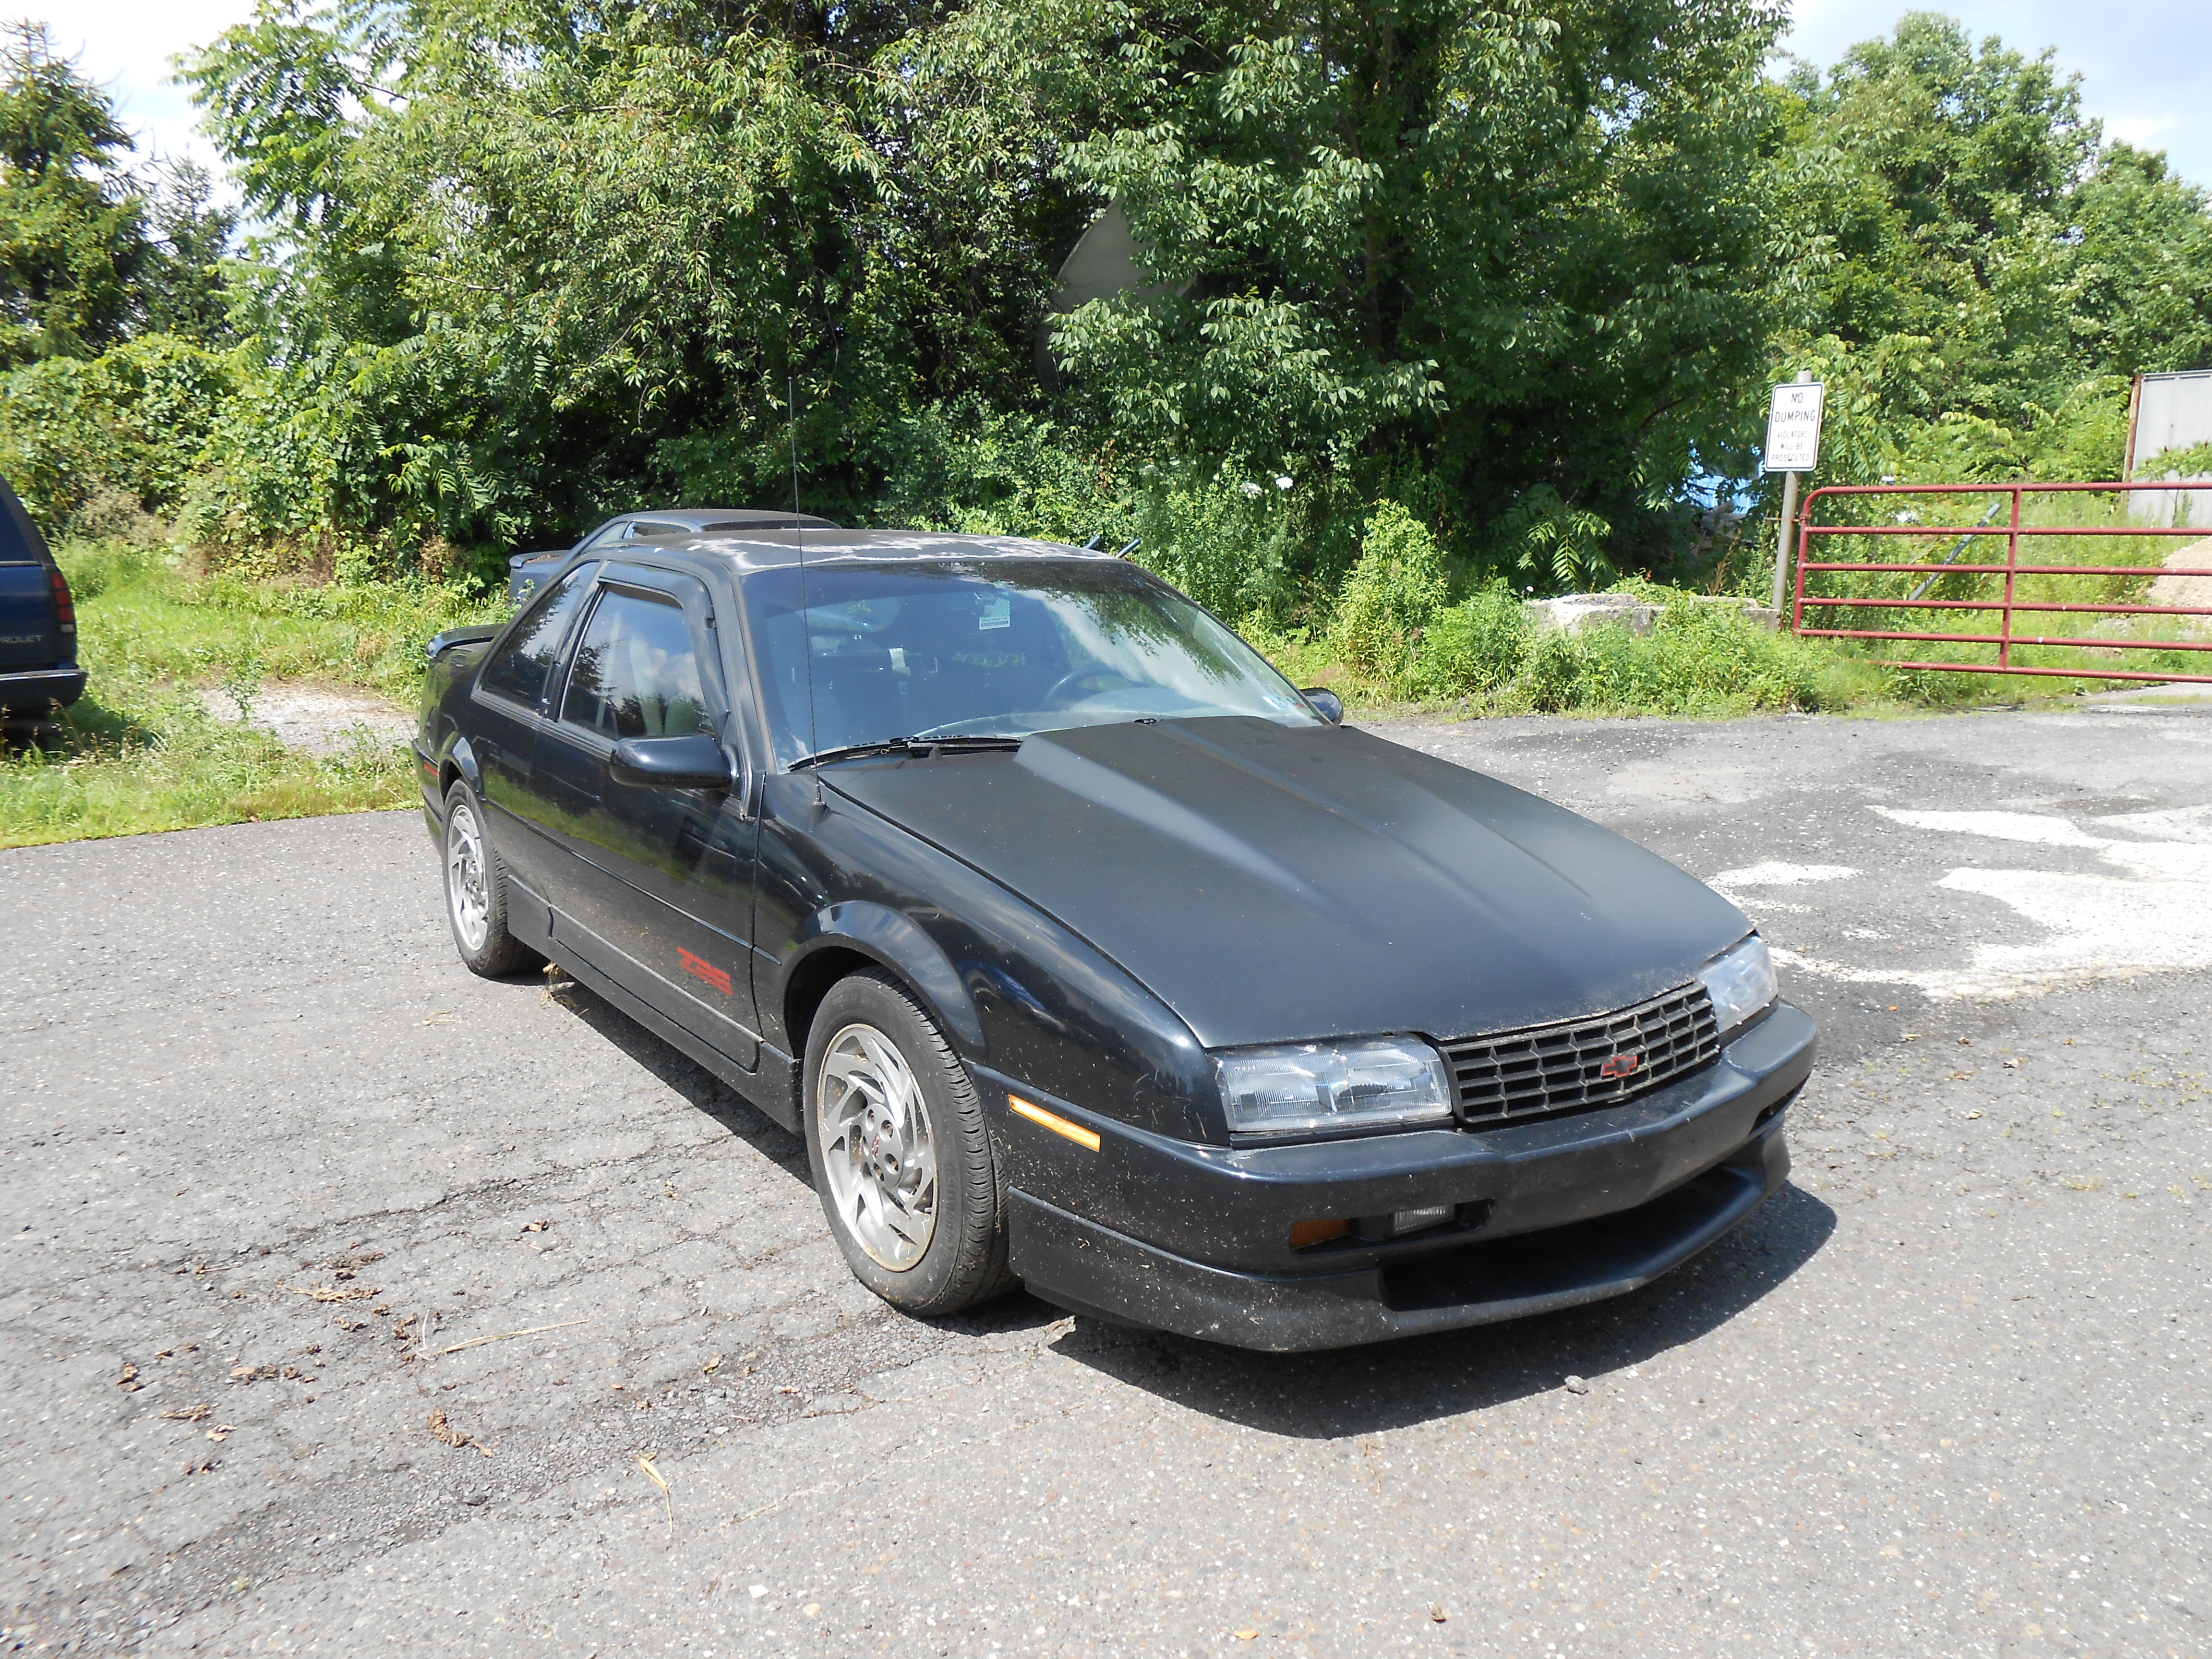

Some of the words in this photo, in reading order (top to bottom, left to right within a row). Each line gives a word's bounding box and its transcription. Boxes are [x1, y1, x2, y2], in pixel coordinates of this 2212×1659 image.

[1791, 392, 1803, 403] NO
[1775, 409, 1815, 422] DUMPING
[1796, 442, 1803, 450] BE
[1772, 454, 1810, 462] PROSECUTED
[0, 635, 44, 644] ROLET
